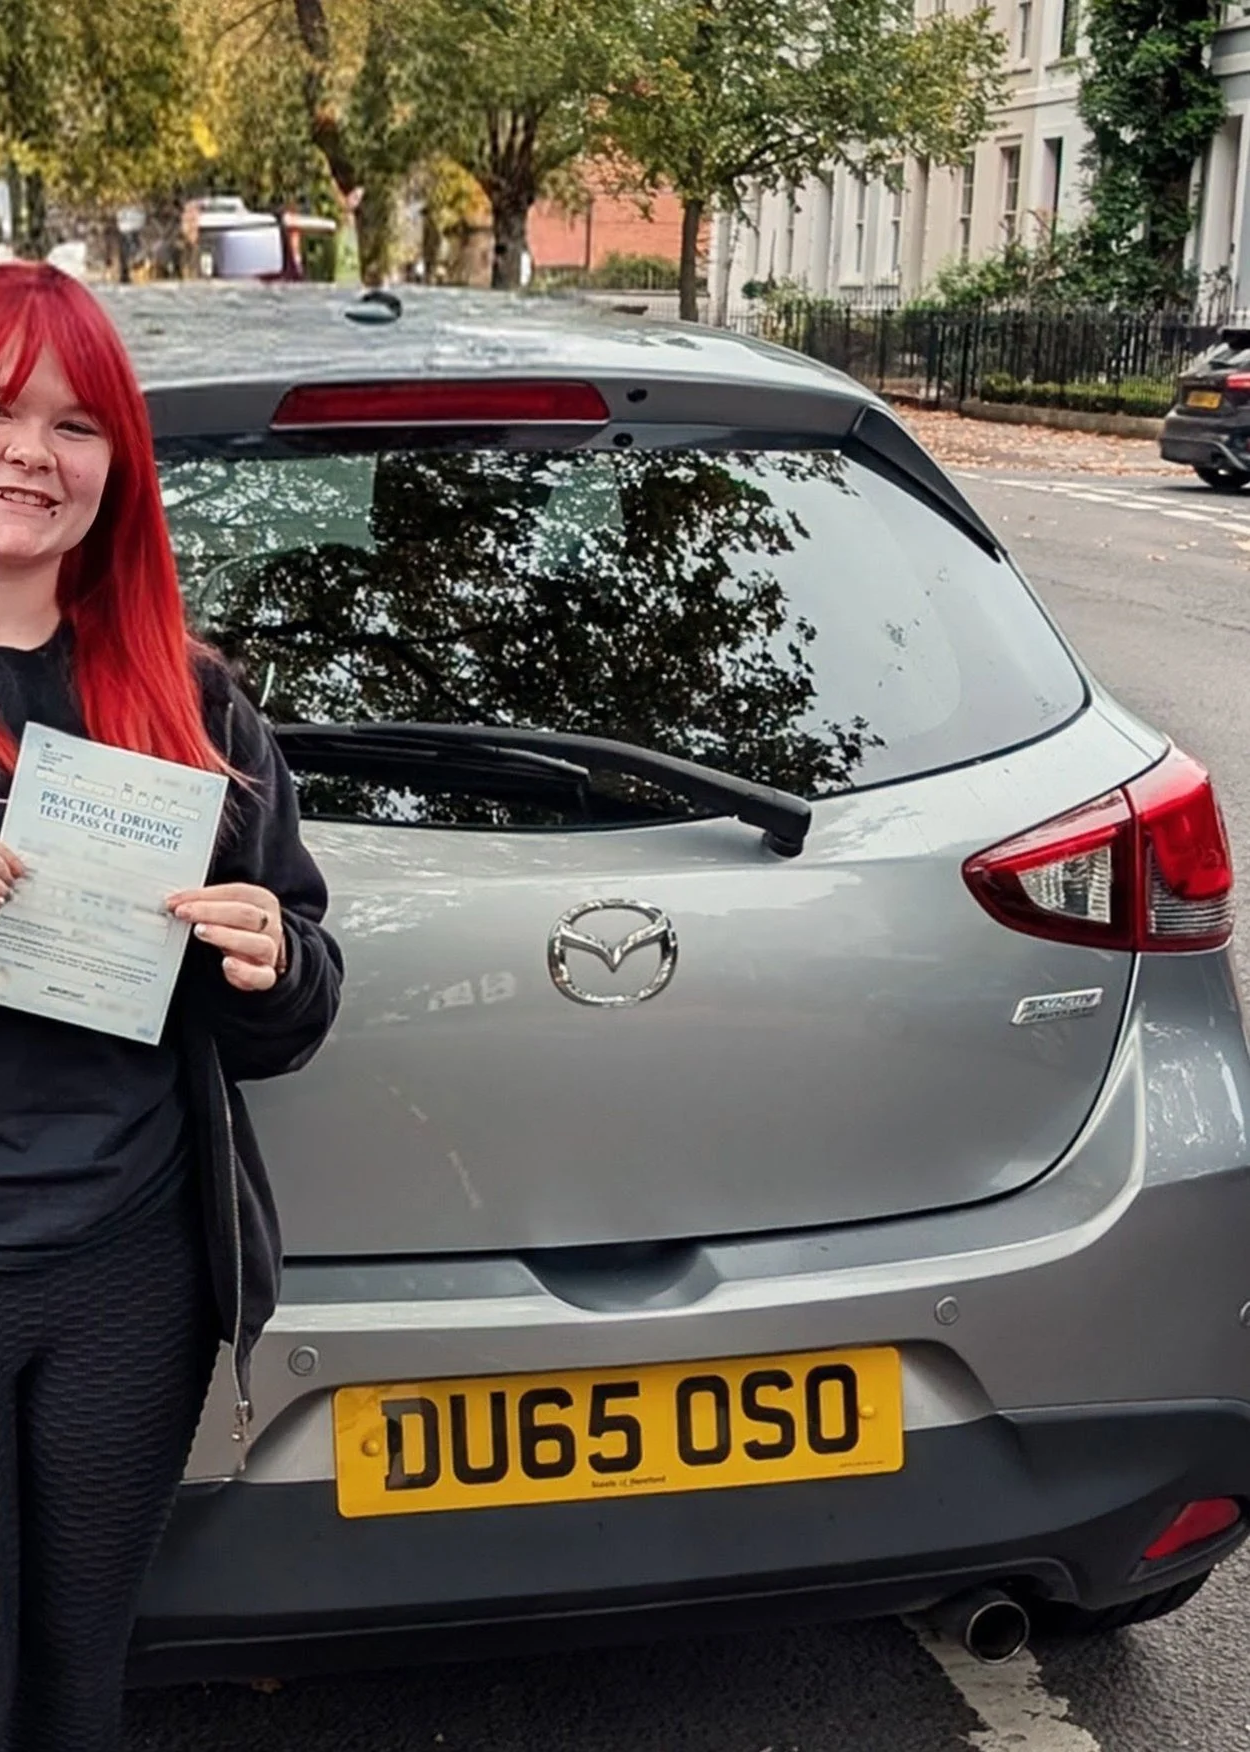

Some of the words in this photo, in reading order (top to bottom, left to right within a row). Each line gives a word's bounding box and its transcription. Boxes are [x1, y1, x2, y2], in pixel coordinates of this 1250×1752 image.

[38, 804, 67, 821] TEST
[69, 812, 101, 830] PASS
[101, 821, 181, 851] CERTIFICATE
[39, 789, 117, 821] PRACTICAL
[119, 811, 184, 839] DRIVING
[380, 1381, 643, 1492] DU65
[675, 1363, 859, 1468] OSO
